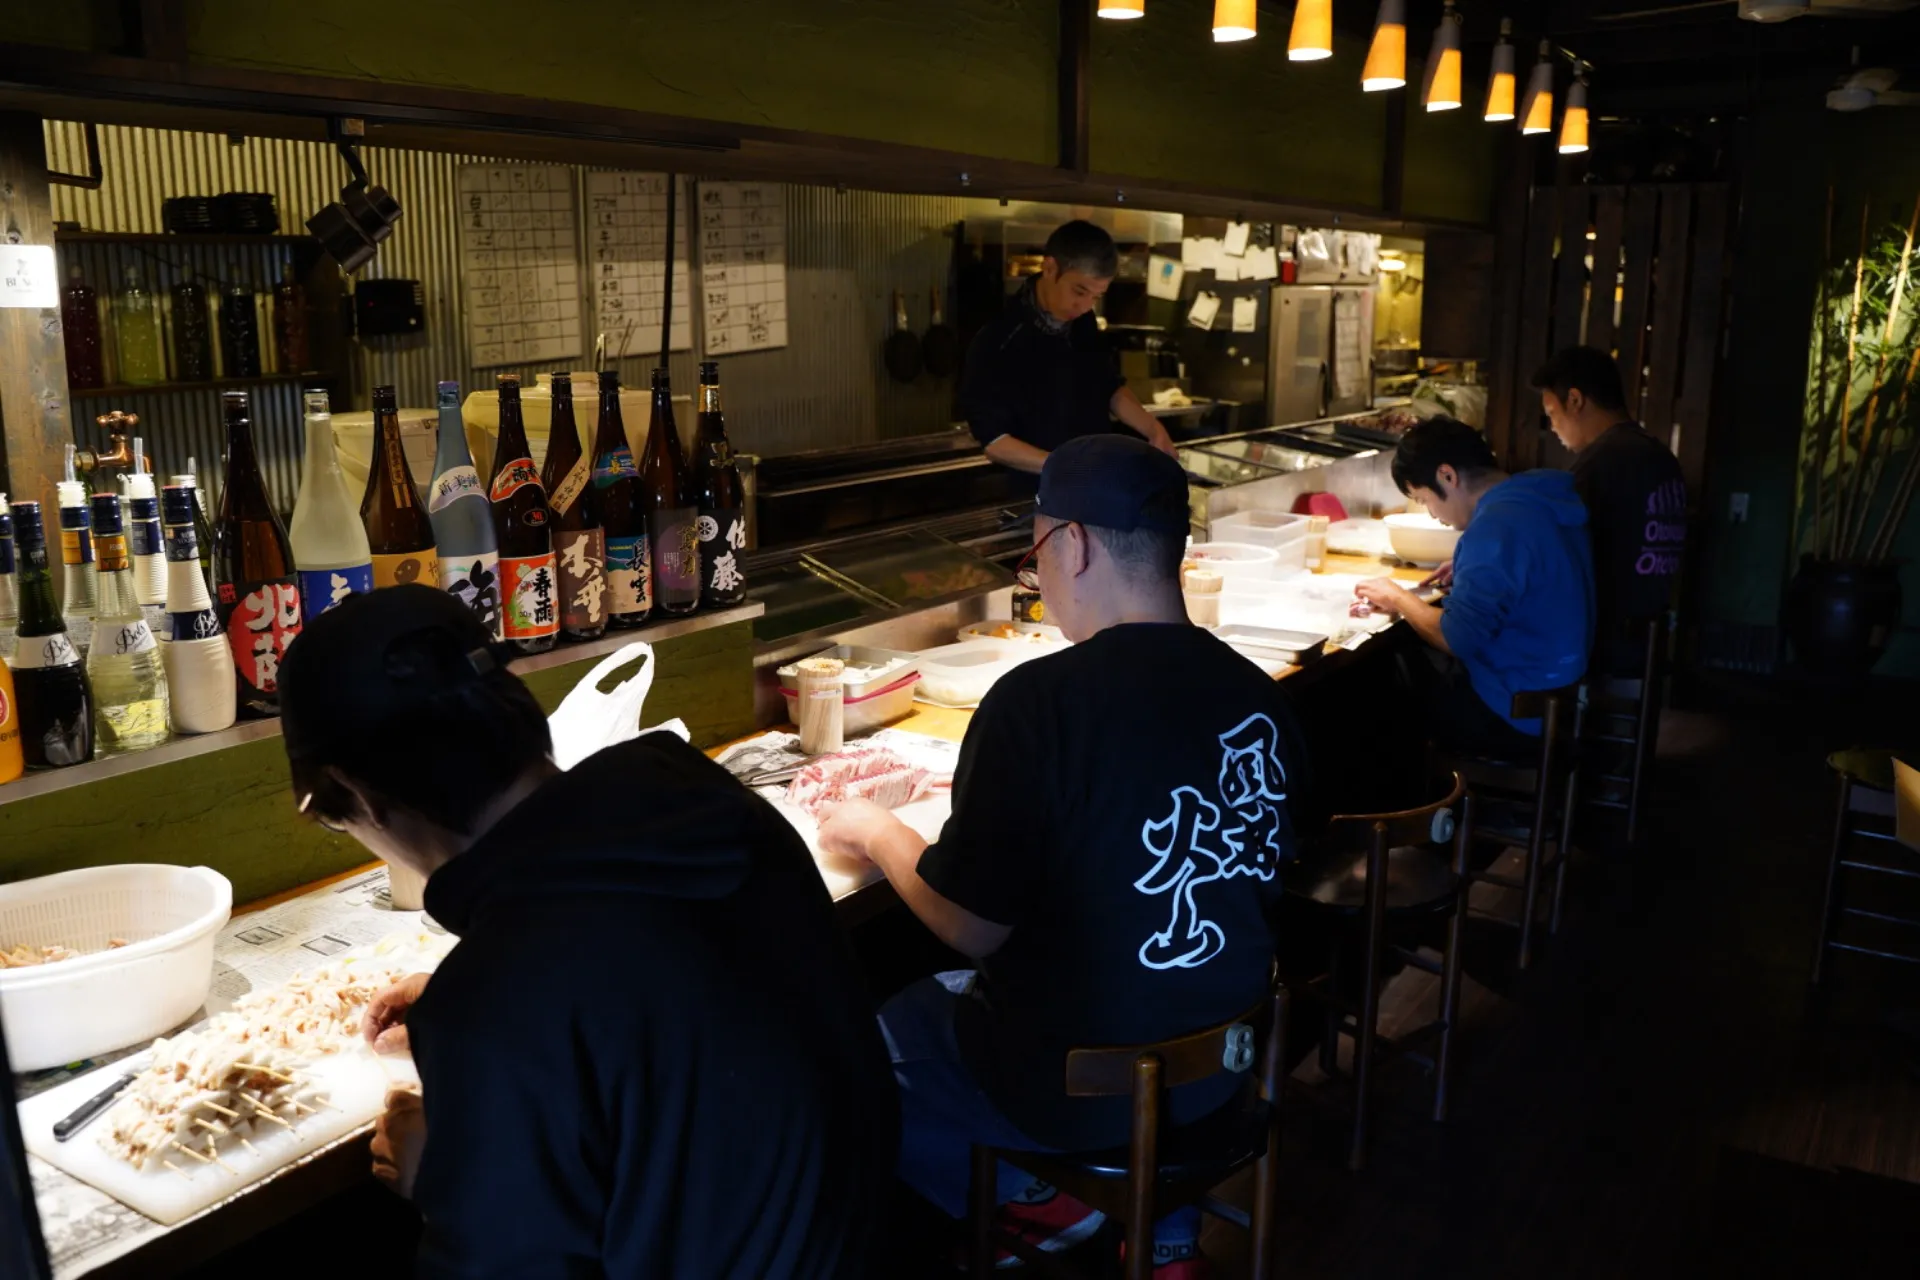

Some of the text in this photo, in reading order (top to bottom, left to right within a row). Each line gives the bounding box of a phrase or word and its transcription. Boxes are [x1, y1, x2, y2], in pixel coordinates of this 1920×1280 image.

[710, 516, 747, 591] 佐藤
[532, 567, 554, 625] 春雨
[115, 623, 147, 655] Bols
[1222, 1022, 1255, 1074] 8
